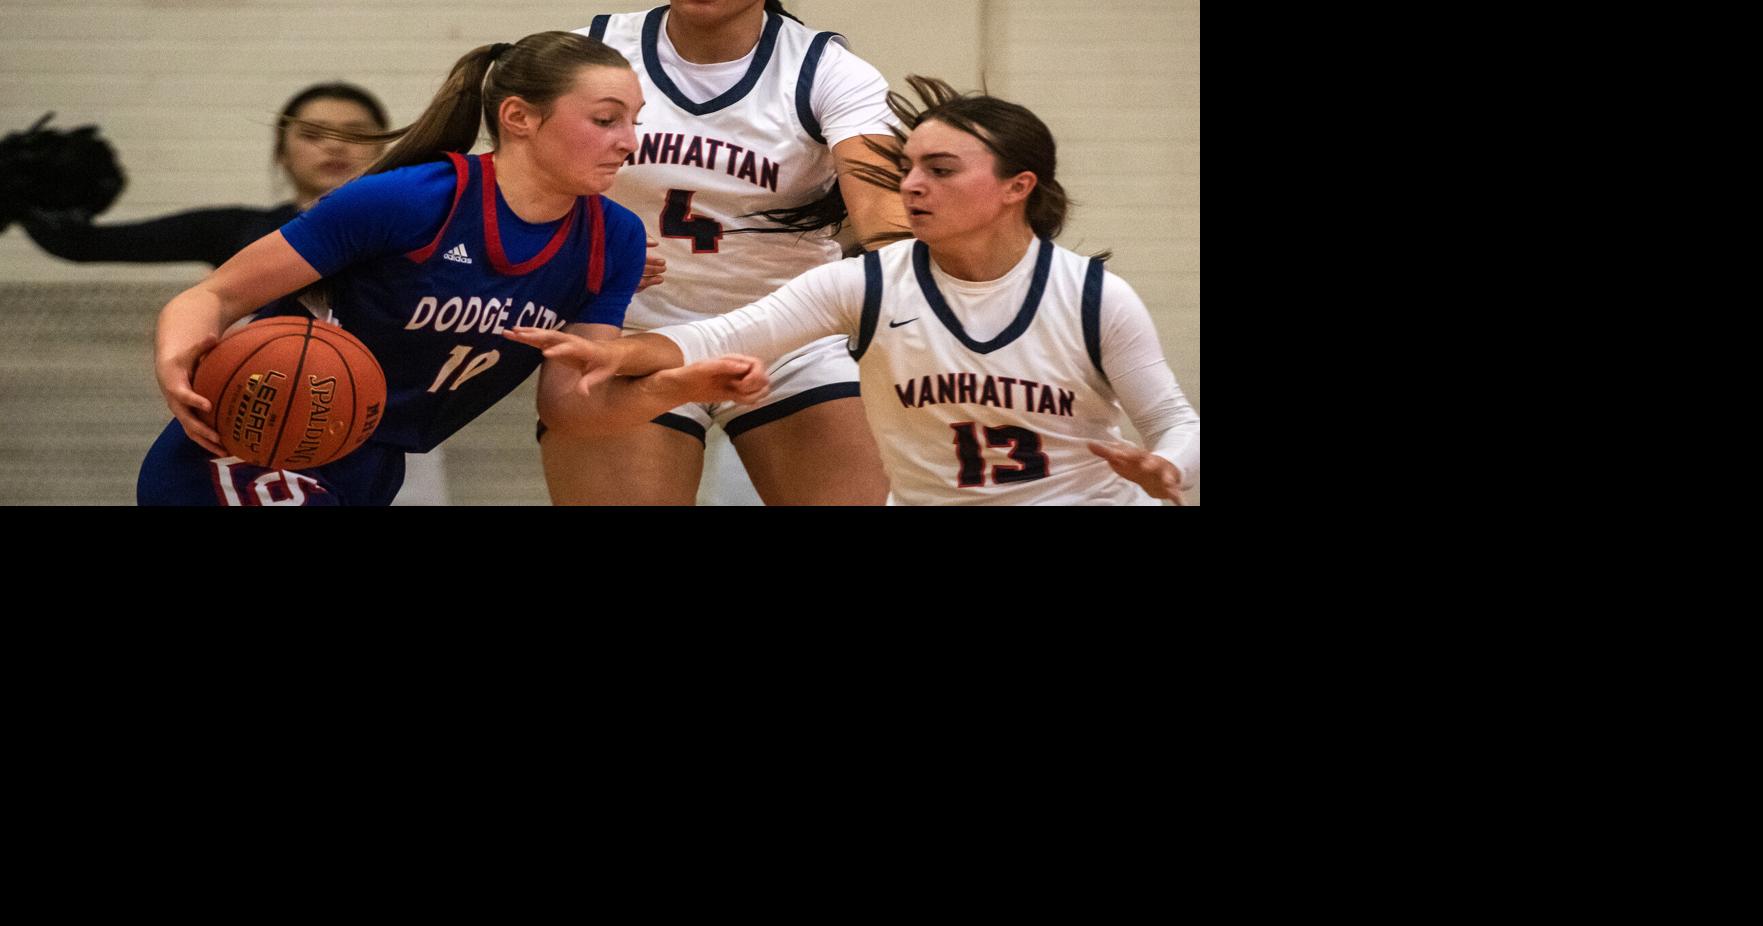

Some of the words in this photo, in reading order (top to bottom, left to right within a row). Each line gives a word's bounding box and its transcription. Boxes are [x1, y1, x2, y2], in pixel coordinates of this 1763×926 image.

[659, 188, 723, 254] 4
[443, 252, 472, 264] adidas
[404, 296, 513, 335] DODGE
[427, 344, 500, 393] 10
[894, 372, 1076, 417] MANHATTAN
[245, 369, 287, 453] LEGACY
[284, 374, 337, 465] SPALDING
[950, 421, 1050, 488] 13
